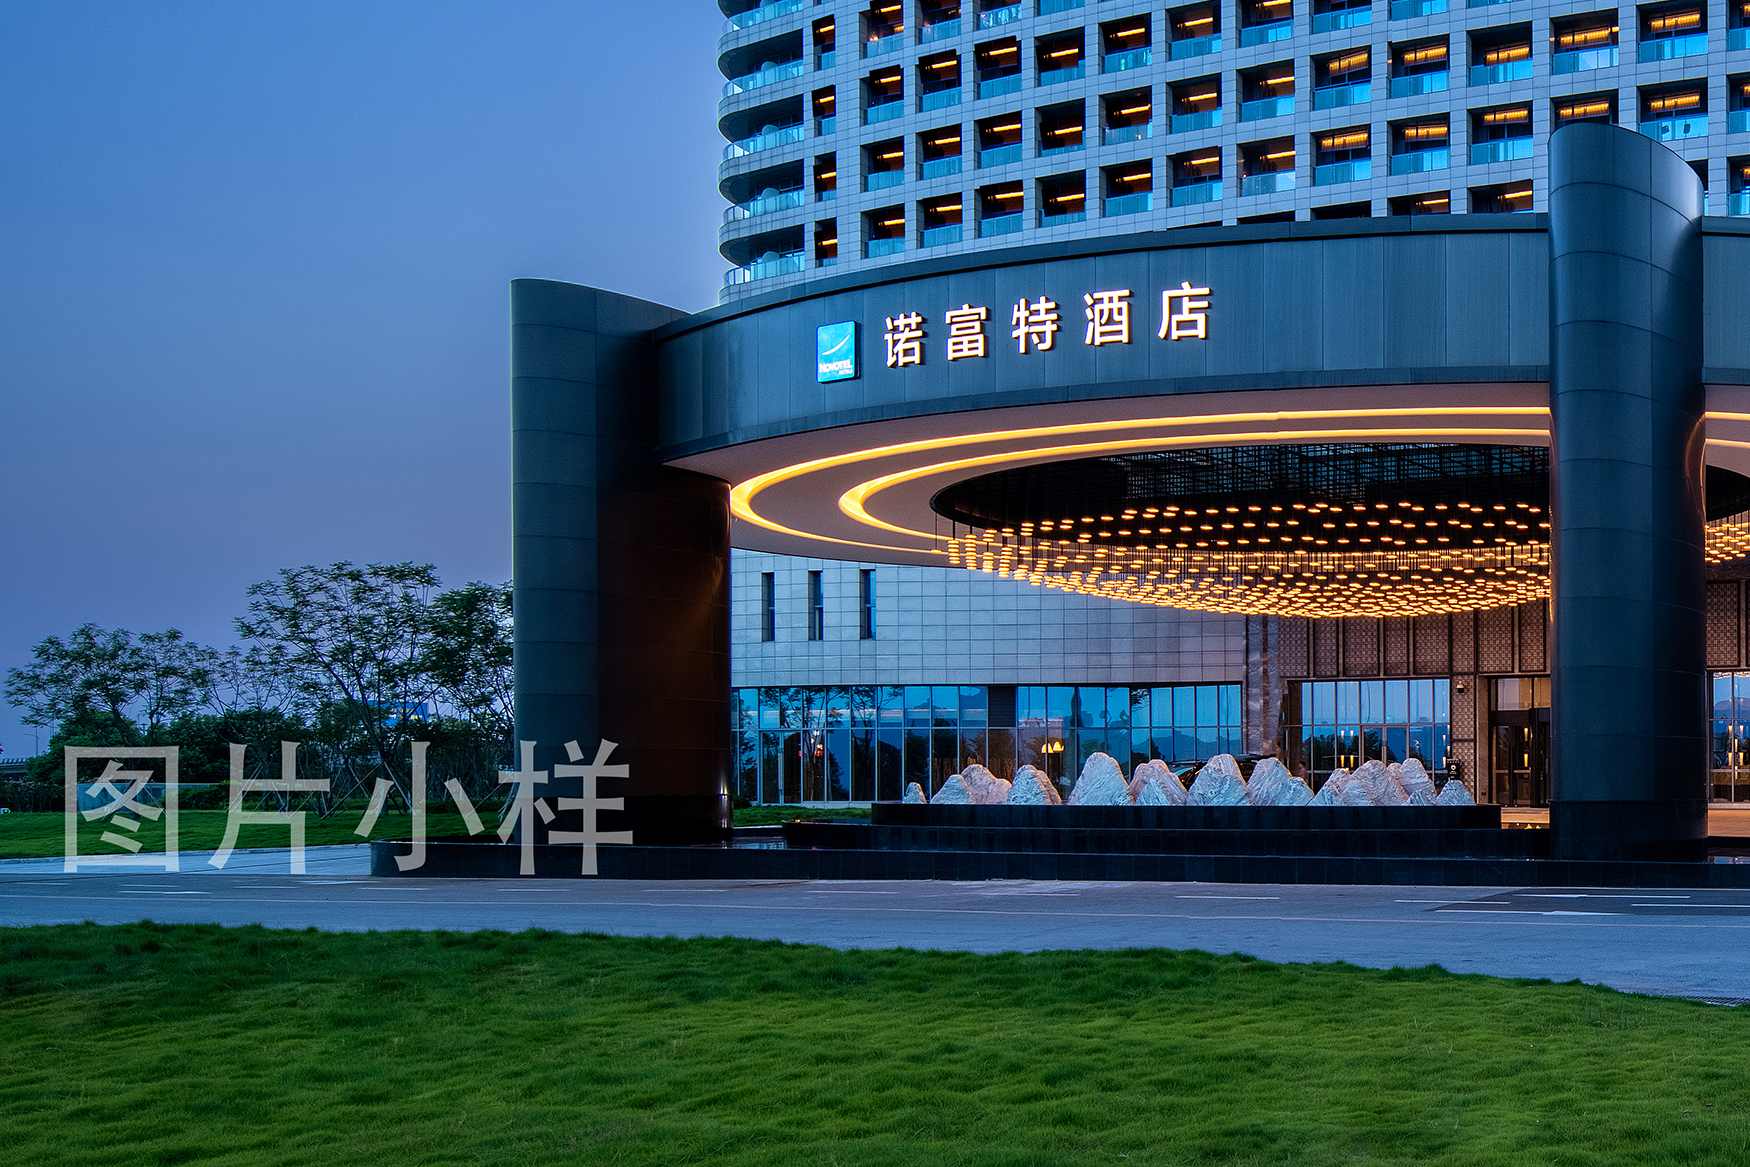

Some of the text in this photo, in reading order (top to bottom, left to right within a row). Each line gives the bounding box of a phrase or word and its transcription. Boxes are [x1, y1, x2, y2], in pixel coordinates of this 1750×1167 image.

[884, 281, 1211, 368] 诺富特酒店
[819, 359, 853, 373] NOVOTEL
